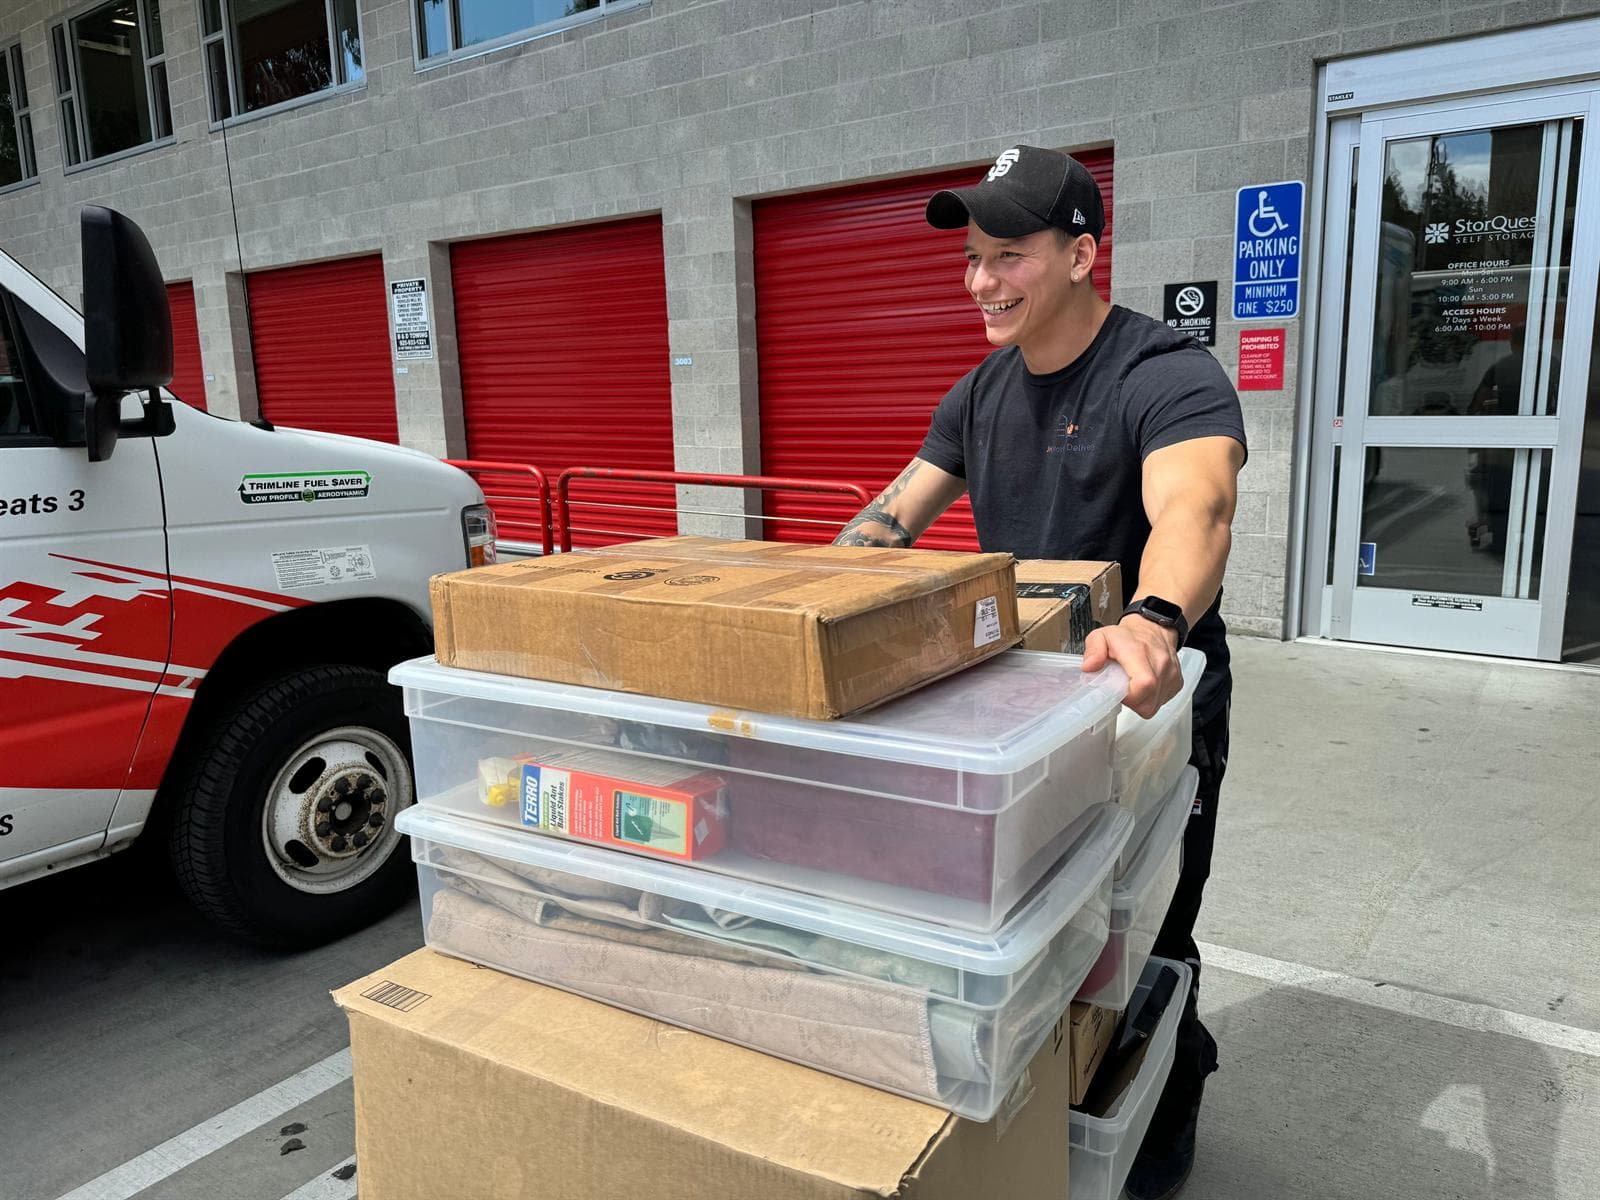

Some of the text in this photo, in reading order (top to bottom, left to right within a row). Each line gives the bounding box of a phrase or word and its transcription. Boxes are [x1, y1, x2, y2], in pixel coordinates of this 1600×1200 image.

[1454, 215, 1536, 234] StorQues
[1456, 231, 1535, 244] SELF STORAG
[1239, 236, 1298, 258] PARKING
[1250, 259, 1285, 280] ONLY
[1479, 259, 1510, 268] HOURS
[1245, 284, 1287, 299] MINIMUM
[1238, 299, 1294, 315] FINE $250
[1442, 308, 1474, 316] ACCESS
[1167, 317, 1211, 328] NO SMOKING
[1452, 317, 1471, 325] Days
[249, 478, 362, 490] TRIMLINE FUEL SAVER
[68, 489, 86, 512] 3
[318, 490, 365, 498] AERODYNAMIC
[524, 775, 538, 824] TERRO
